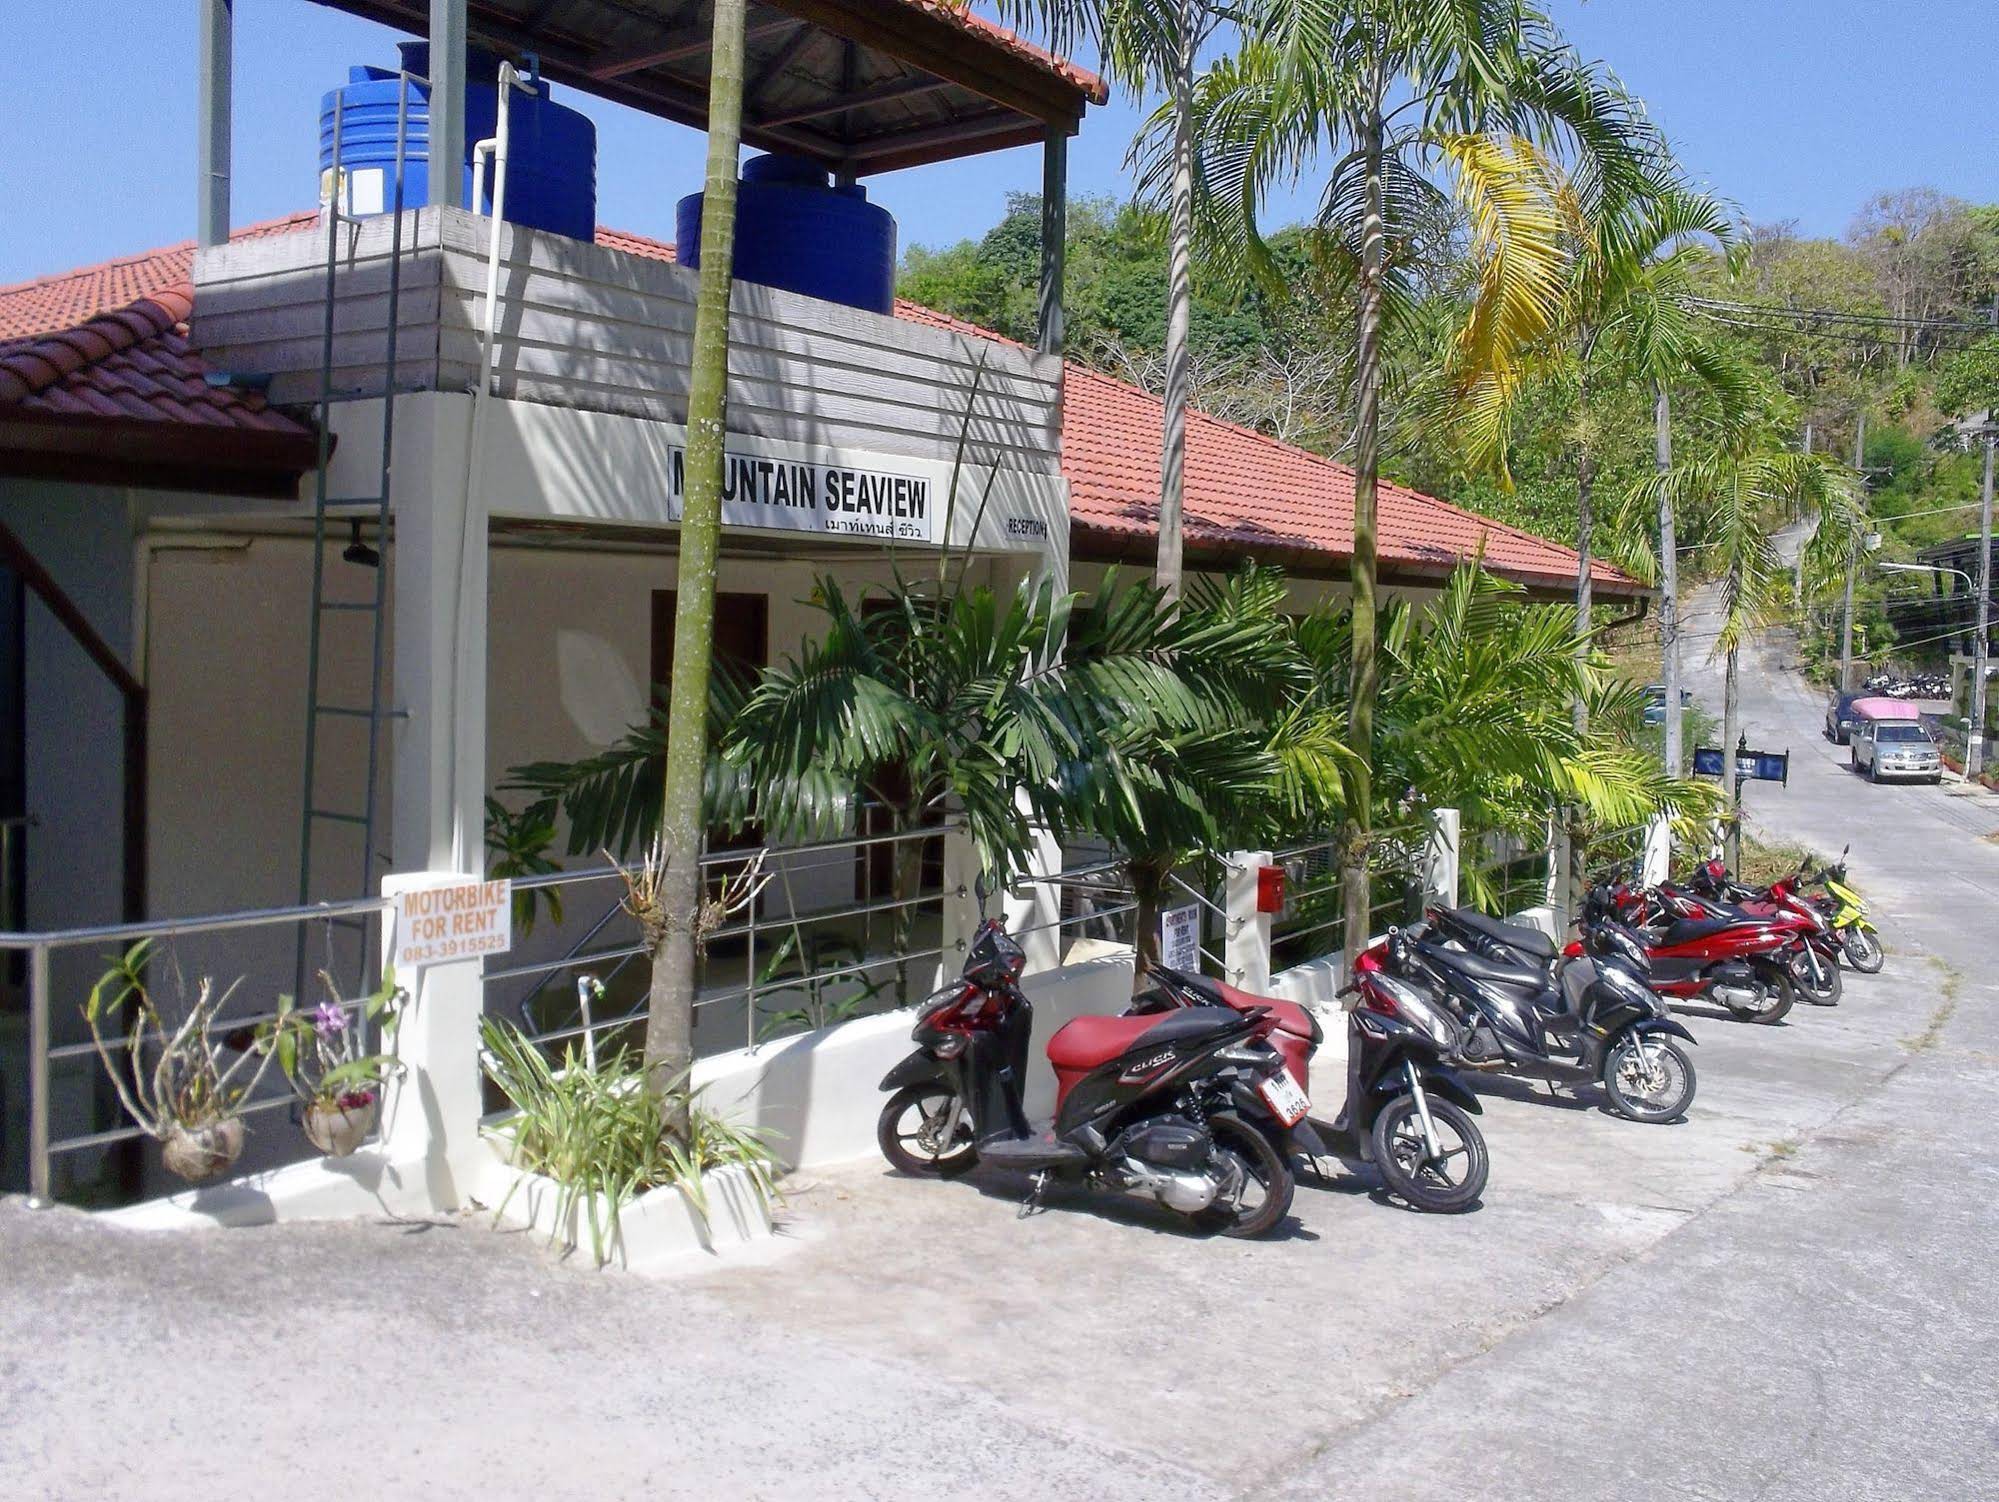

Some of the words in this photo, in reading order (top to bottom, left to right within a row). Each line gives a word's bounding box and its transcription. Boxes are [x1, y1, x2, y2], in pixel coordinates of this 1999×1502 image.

[674, 451, 815, 509] UNTAIN
[825, 470, 926, 519] SEAVIEW
[1008, 518, 1046, 537] RECEPTION
[404, 881, 506, 918] MOTORBIKE
[412, 916, 447, 940] FOR
[453, 909, 498, 934] RENT
[1131, 1050, 1176, 1073] CLICK
